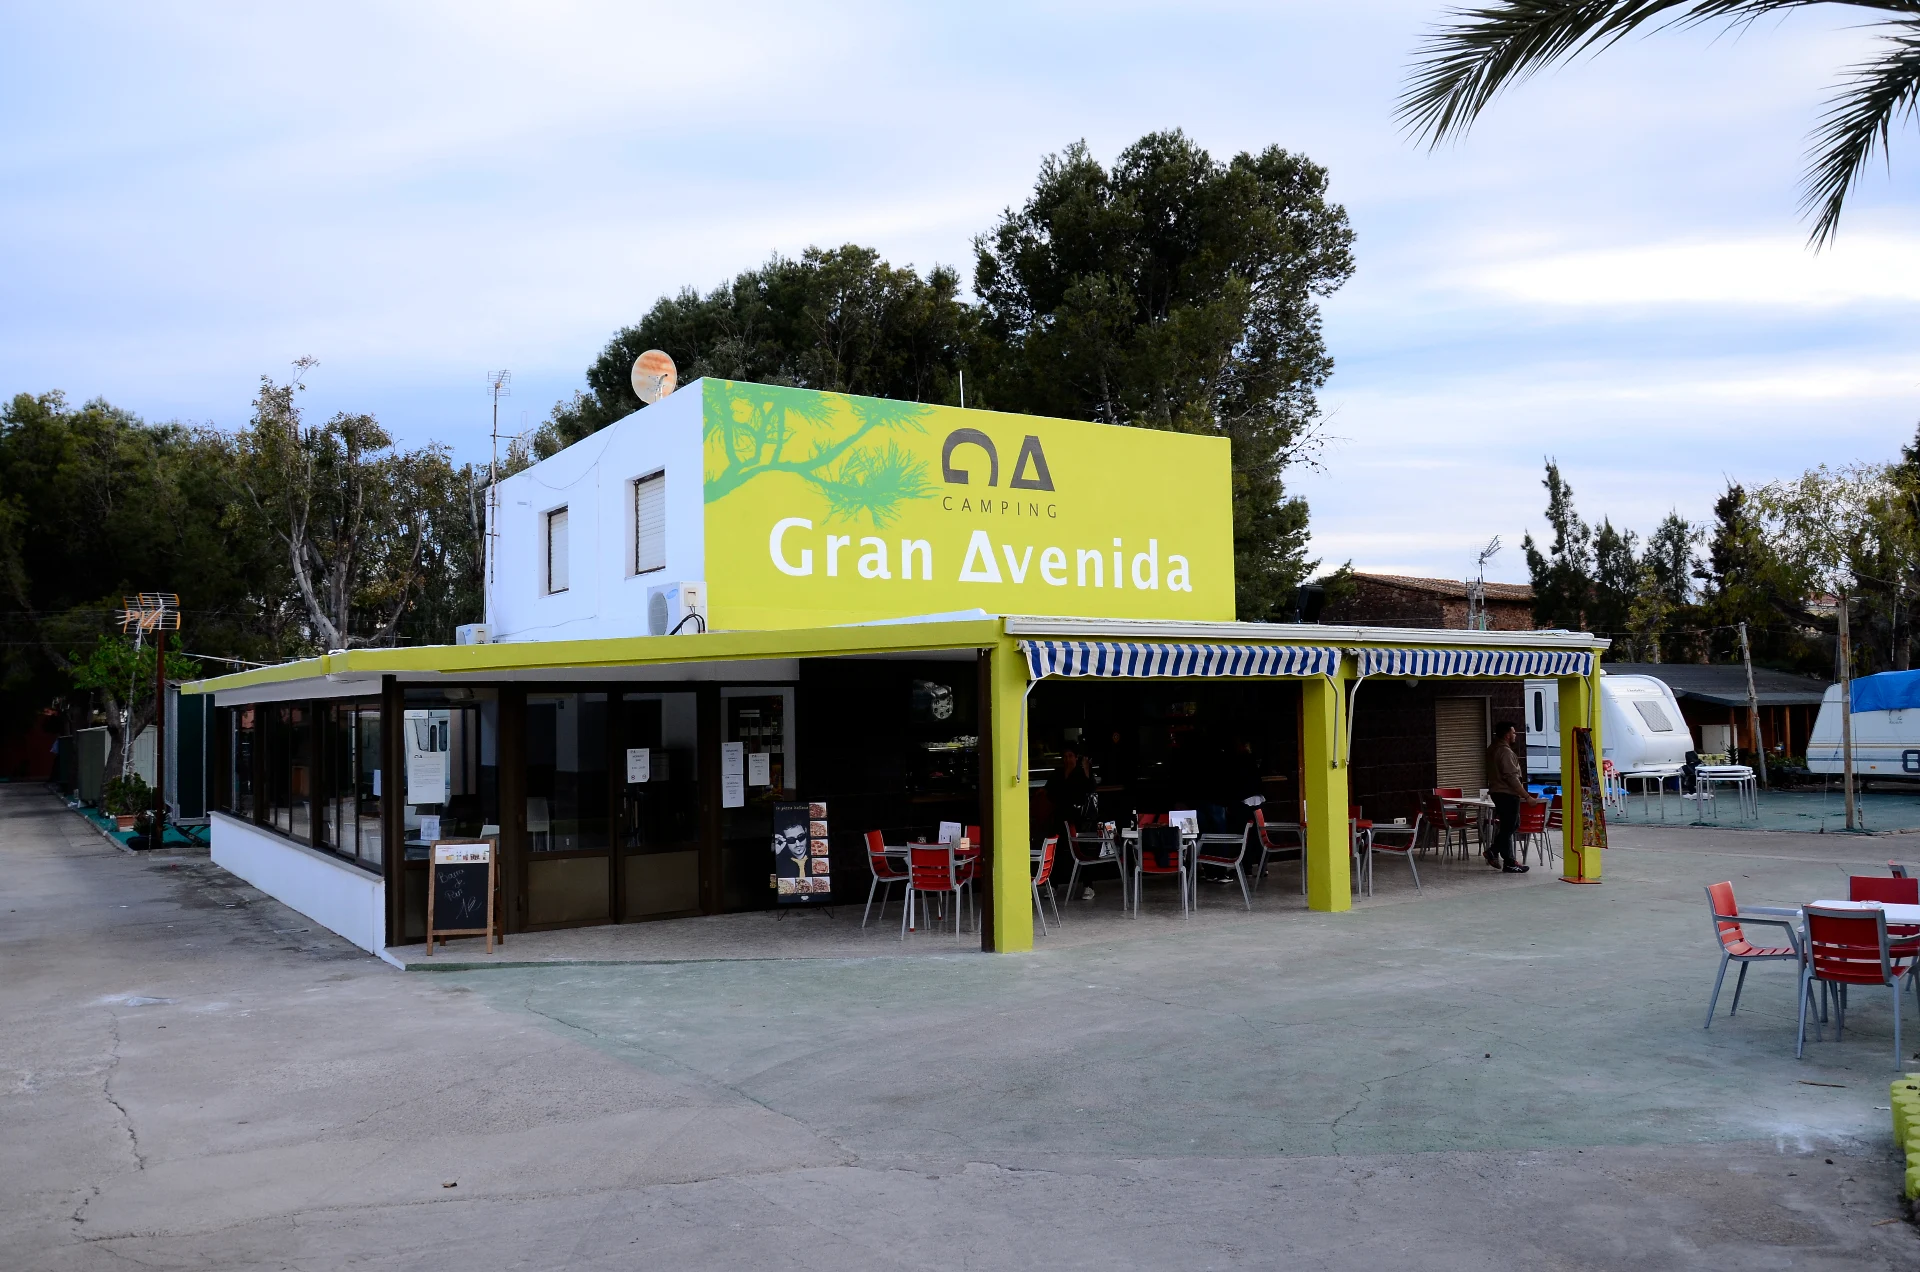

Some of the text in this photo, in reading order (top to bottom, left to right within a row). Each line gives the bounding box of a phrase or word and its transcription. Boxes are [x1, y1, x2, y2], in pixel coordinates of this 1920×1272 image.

[941, 496, 1057, 518] CAMPING
[769, 517, 1193, 593] Gran Avenida
